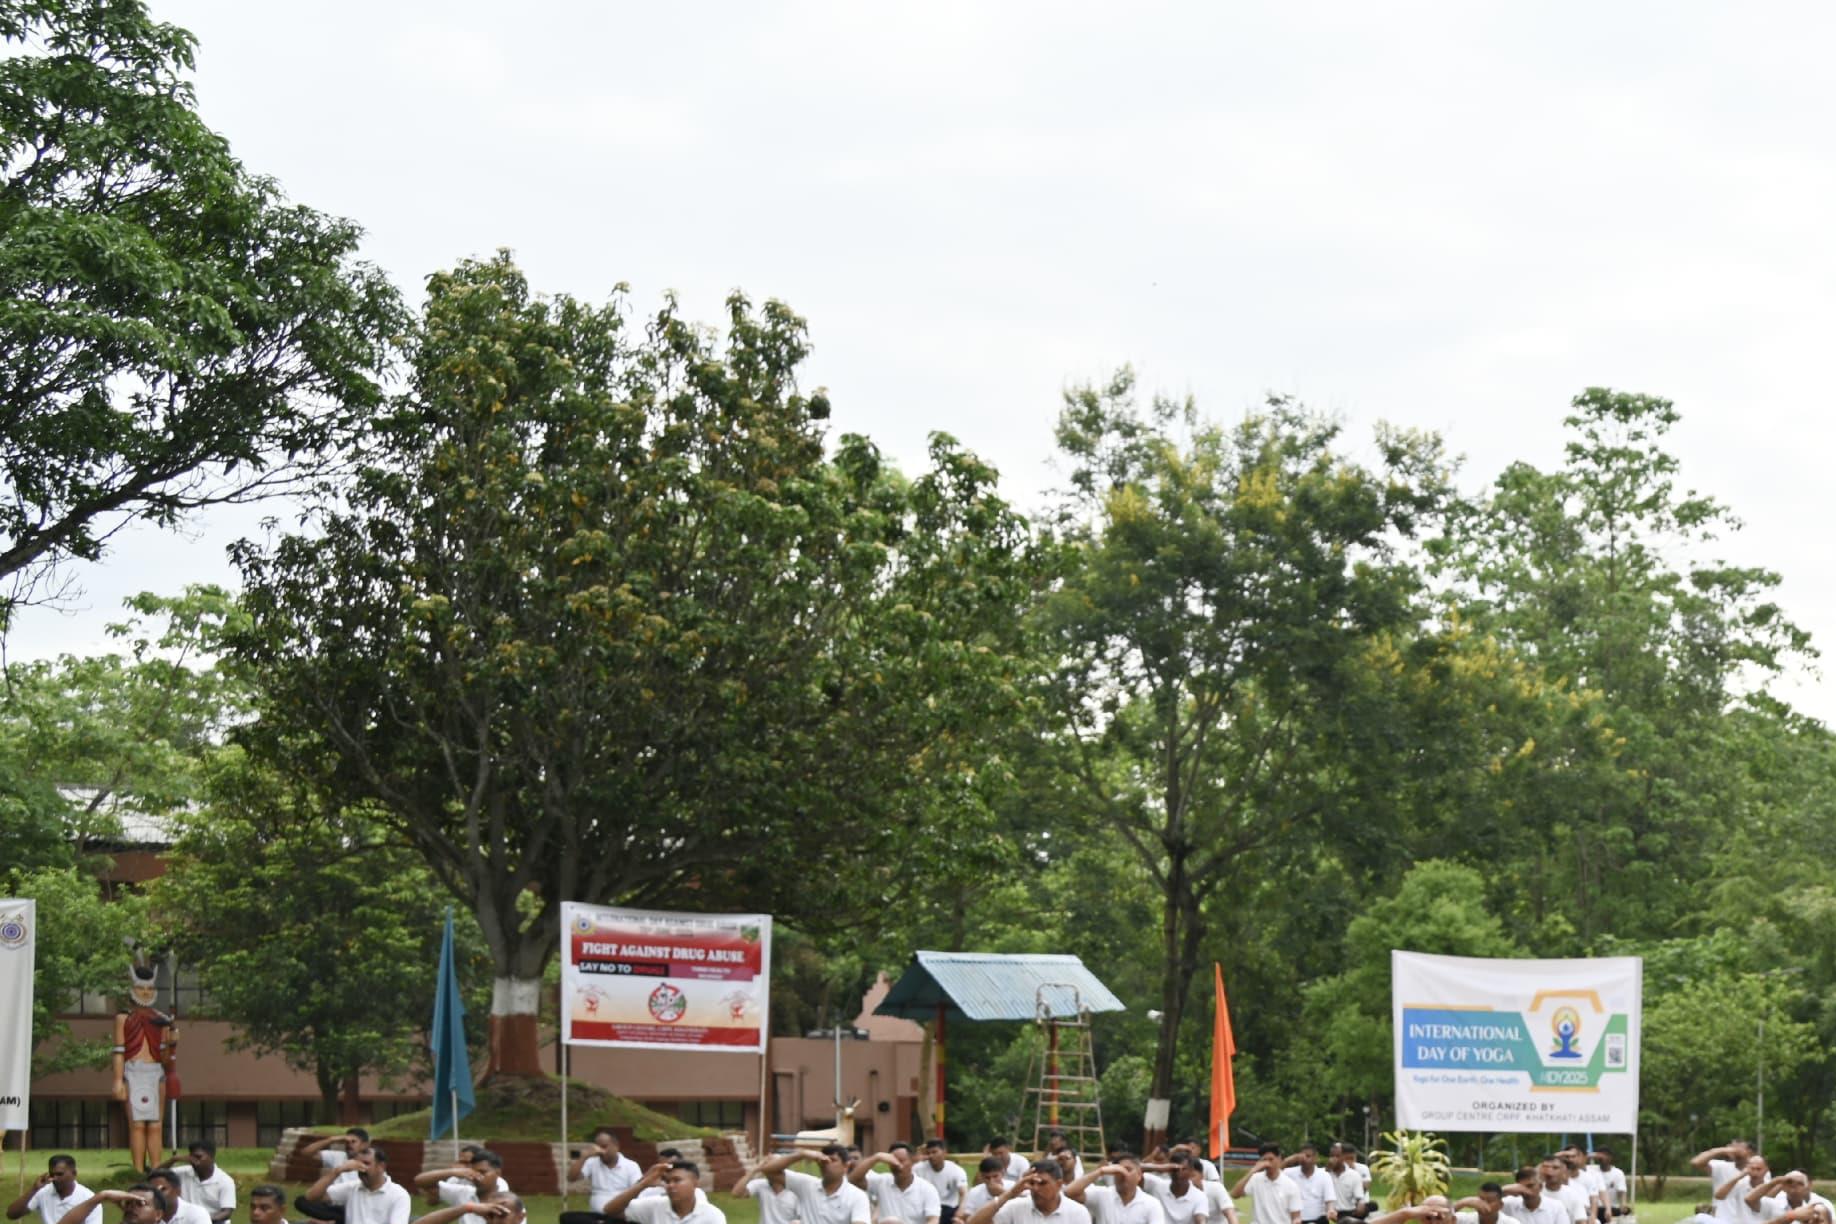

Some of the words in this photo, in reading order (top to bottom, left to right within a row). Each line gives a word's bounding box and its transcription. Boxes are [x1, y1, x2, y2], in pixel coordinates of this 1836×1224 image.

[582, 942, 618, 956] FIGHT
[621, 945, 669, 959] AGAINST
[672, 948, 705, 961] DRUG
[707, 951, 744, 963] ABUSE
[579, 963, 599, 972] SAY
[601, 963, 615, 973] NO
[617, 964, 631, 974] TO
[1409, 1024, 1523, 1041] INTERNATIONAL
[1417, 1046, 1446, 1060] DAY
[1450, 1046, 1470, 1062] OF
[1473, 1048, 1514, 1063] YOGA
[1472, 1101, 1537, 1111] ORGANIZED
[1541, 1103, 1555, 1111] BY
[1456, 1112, 1494, 1121] CENTRE
